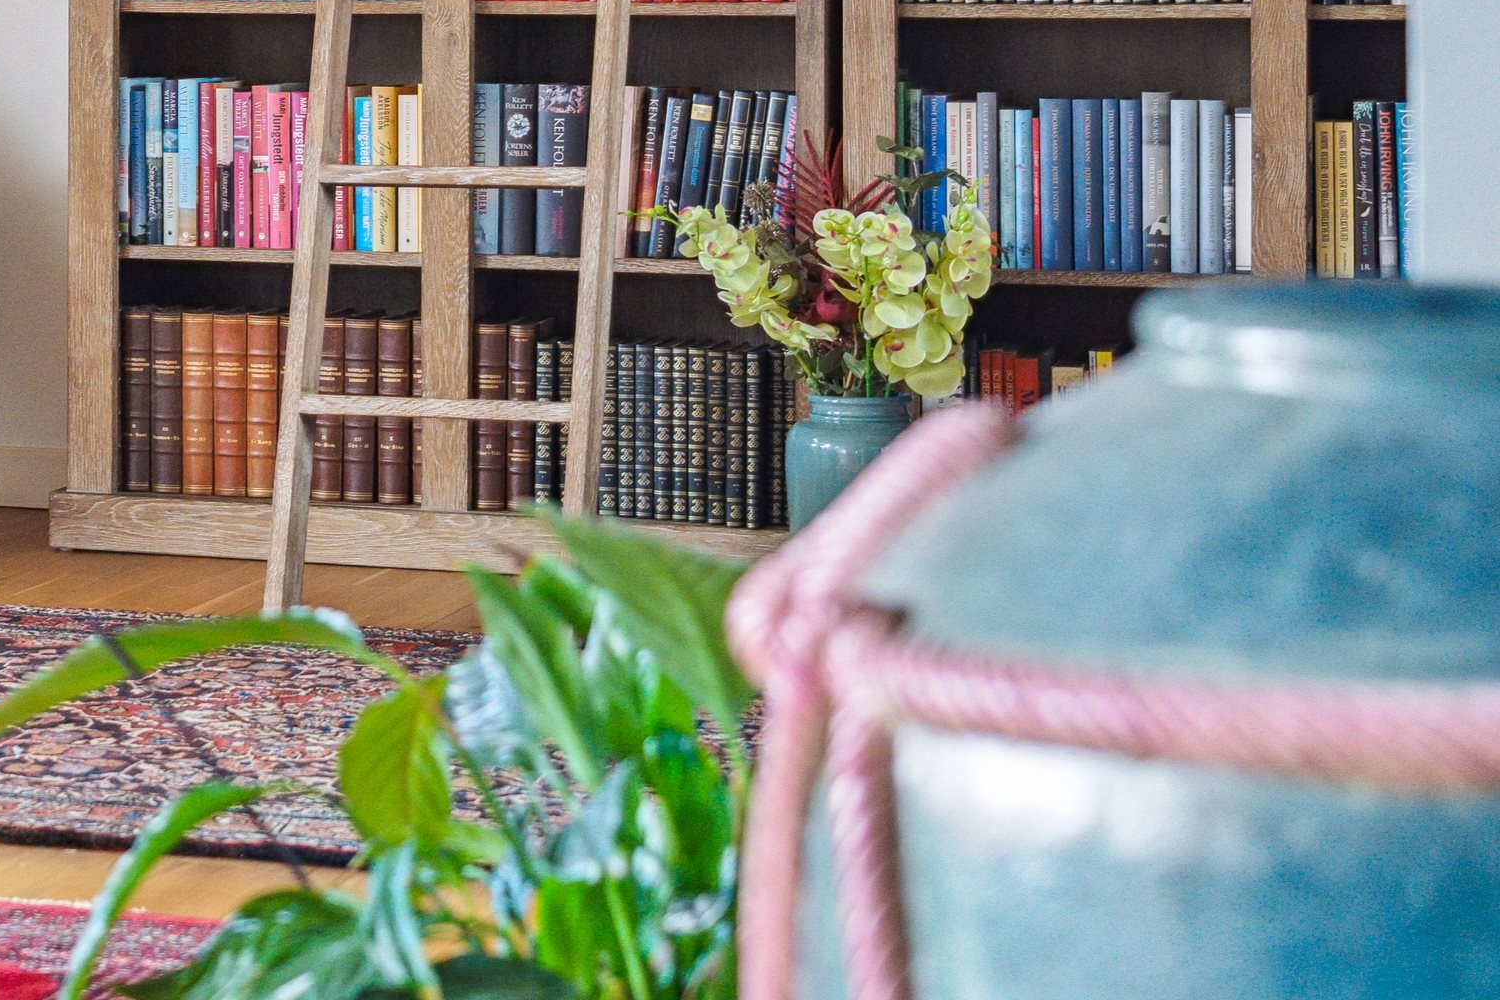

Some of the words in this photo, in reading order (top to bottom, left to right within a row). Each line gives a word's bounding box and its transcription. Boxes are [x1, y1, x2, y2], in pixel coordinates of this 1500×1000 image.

[474, 92, 485, 121] KEN
[648, 99, 658, 122] KEN
[673, 105, 681, 124] KEN
[271, 114, 283, 164] Jungstedt
[293, 113, 306, 165] Jungstedt
[553, 118, 564, 142] KEN
[668, 126, 679, 162] FOLLETT
[1380, 111, 1391, 144] JOHN
[1398, 109, 1415, 154] JOHN
[505, 141, 532, 150] JORDENS
[644, 126, 656, 174] FOLLETT
[1380, 146, 1392, 191] IRVING
[336, 191, 343, 202] DU
[1402, 162, 1416, 221] IRVING
[336, 224, 344, 239] SER
